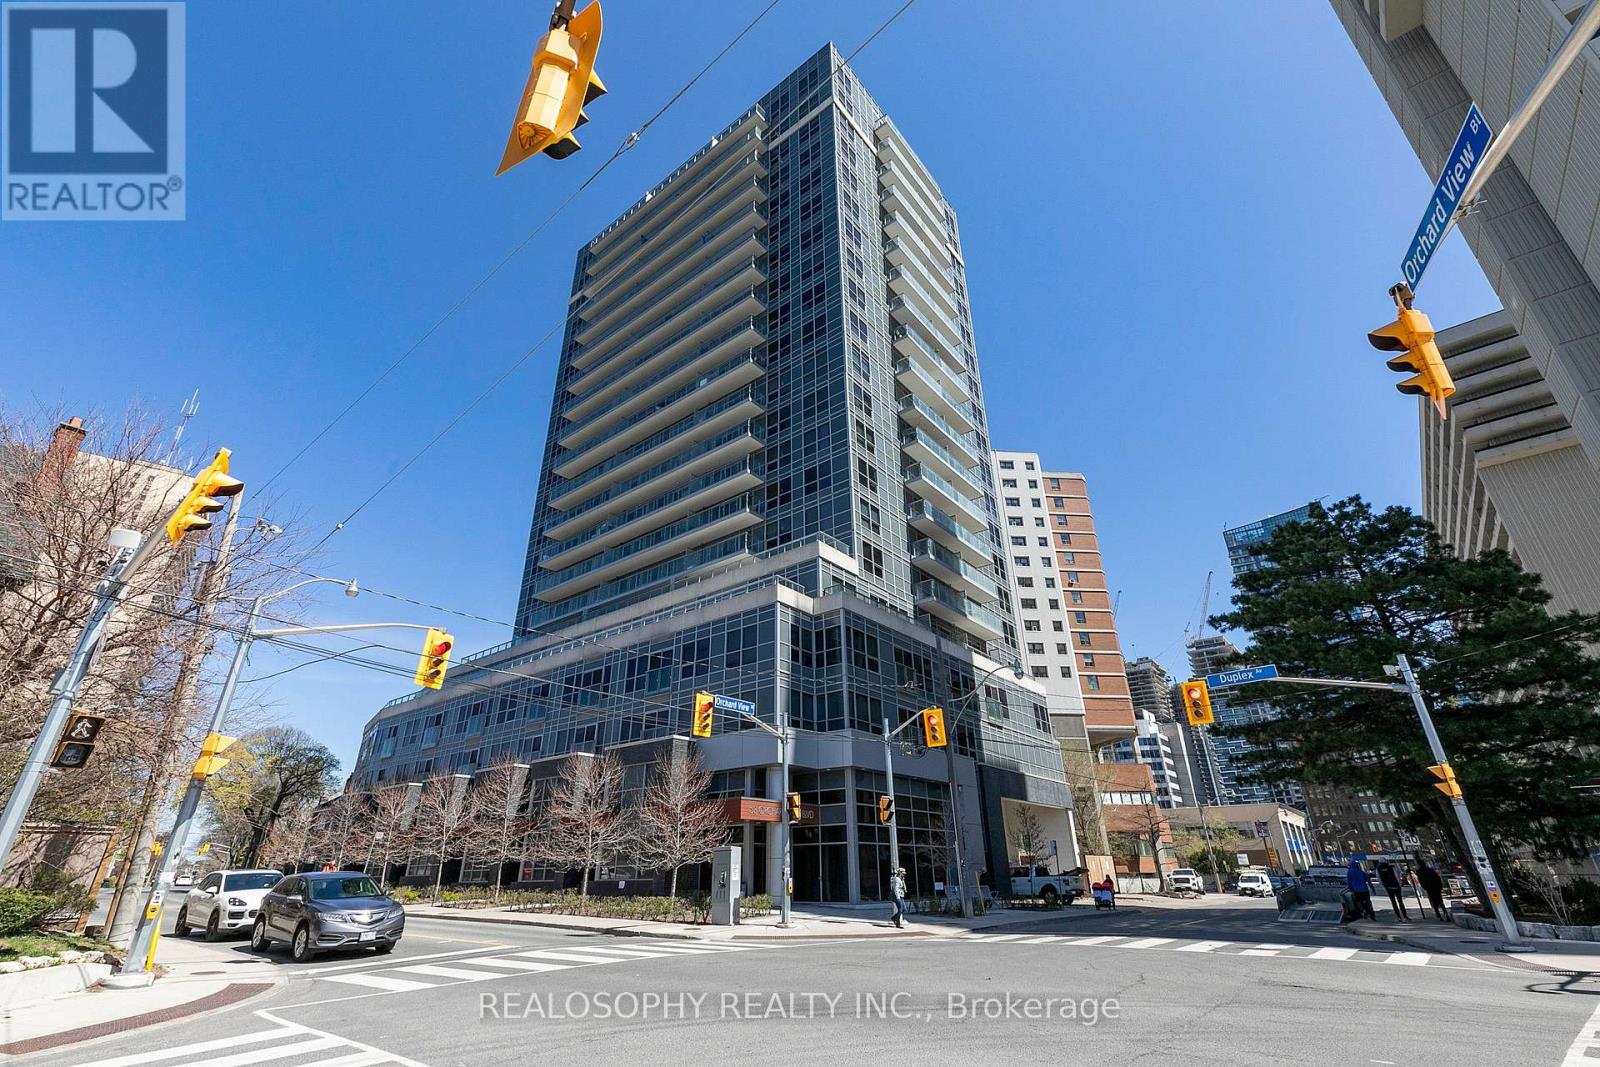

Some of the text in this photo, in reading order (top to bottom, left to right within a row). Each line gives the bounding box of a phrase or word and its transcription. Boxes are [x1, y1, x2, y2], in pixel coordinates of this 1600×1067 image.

[1404, 197, 1448, 285] Orchard
[1441, 141, 1476, 203] View
[1219, 671, 1254, 683] Duplex
[716, 697, 737, 709] Orchard
[737, 701, 750, 711] View
